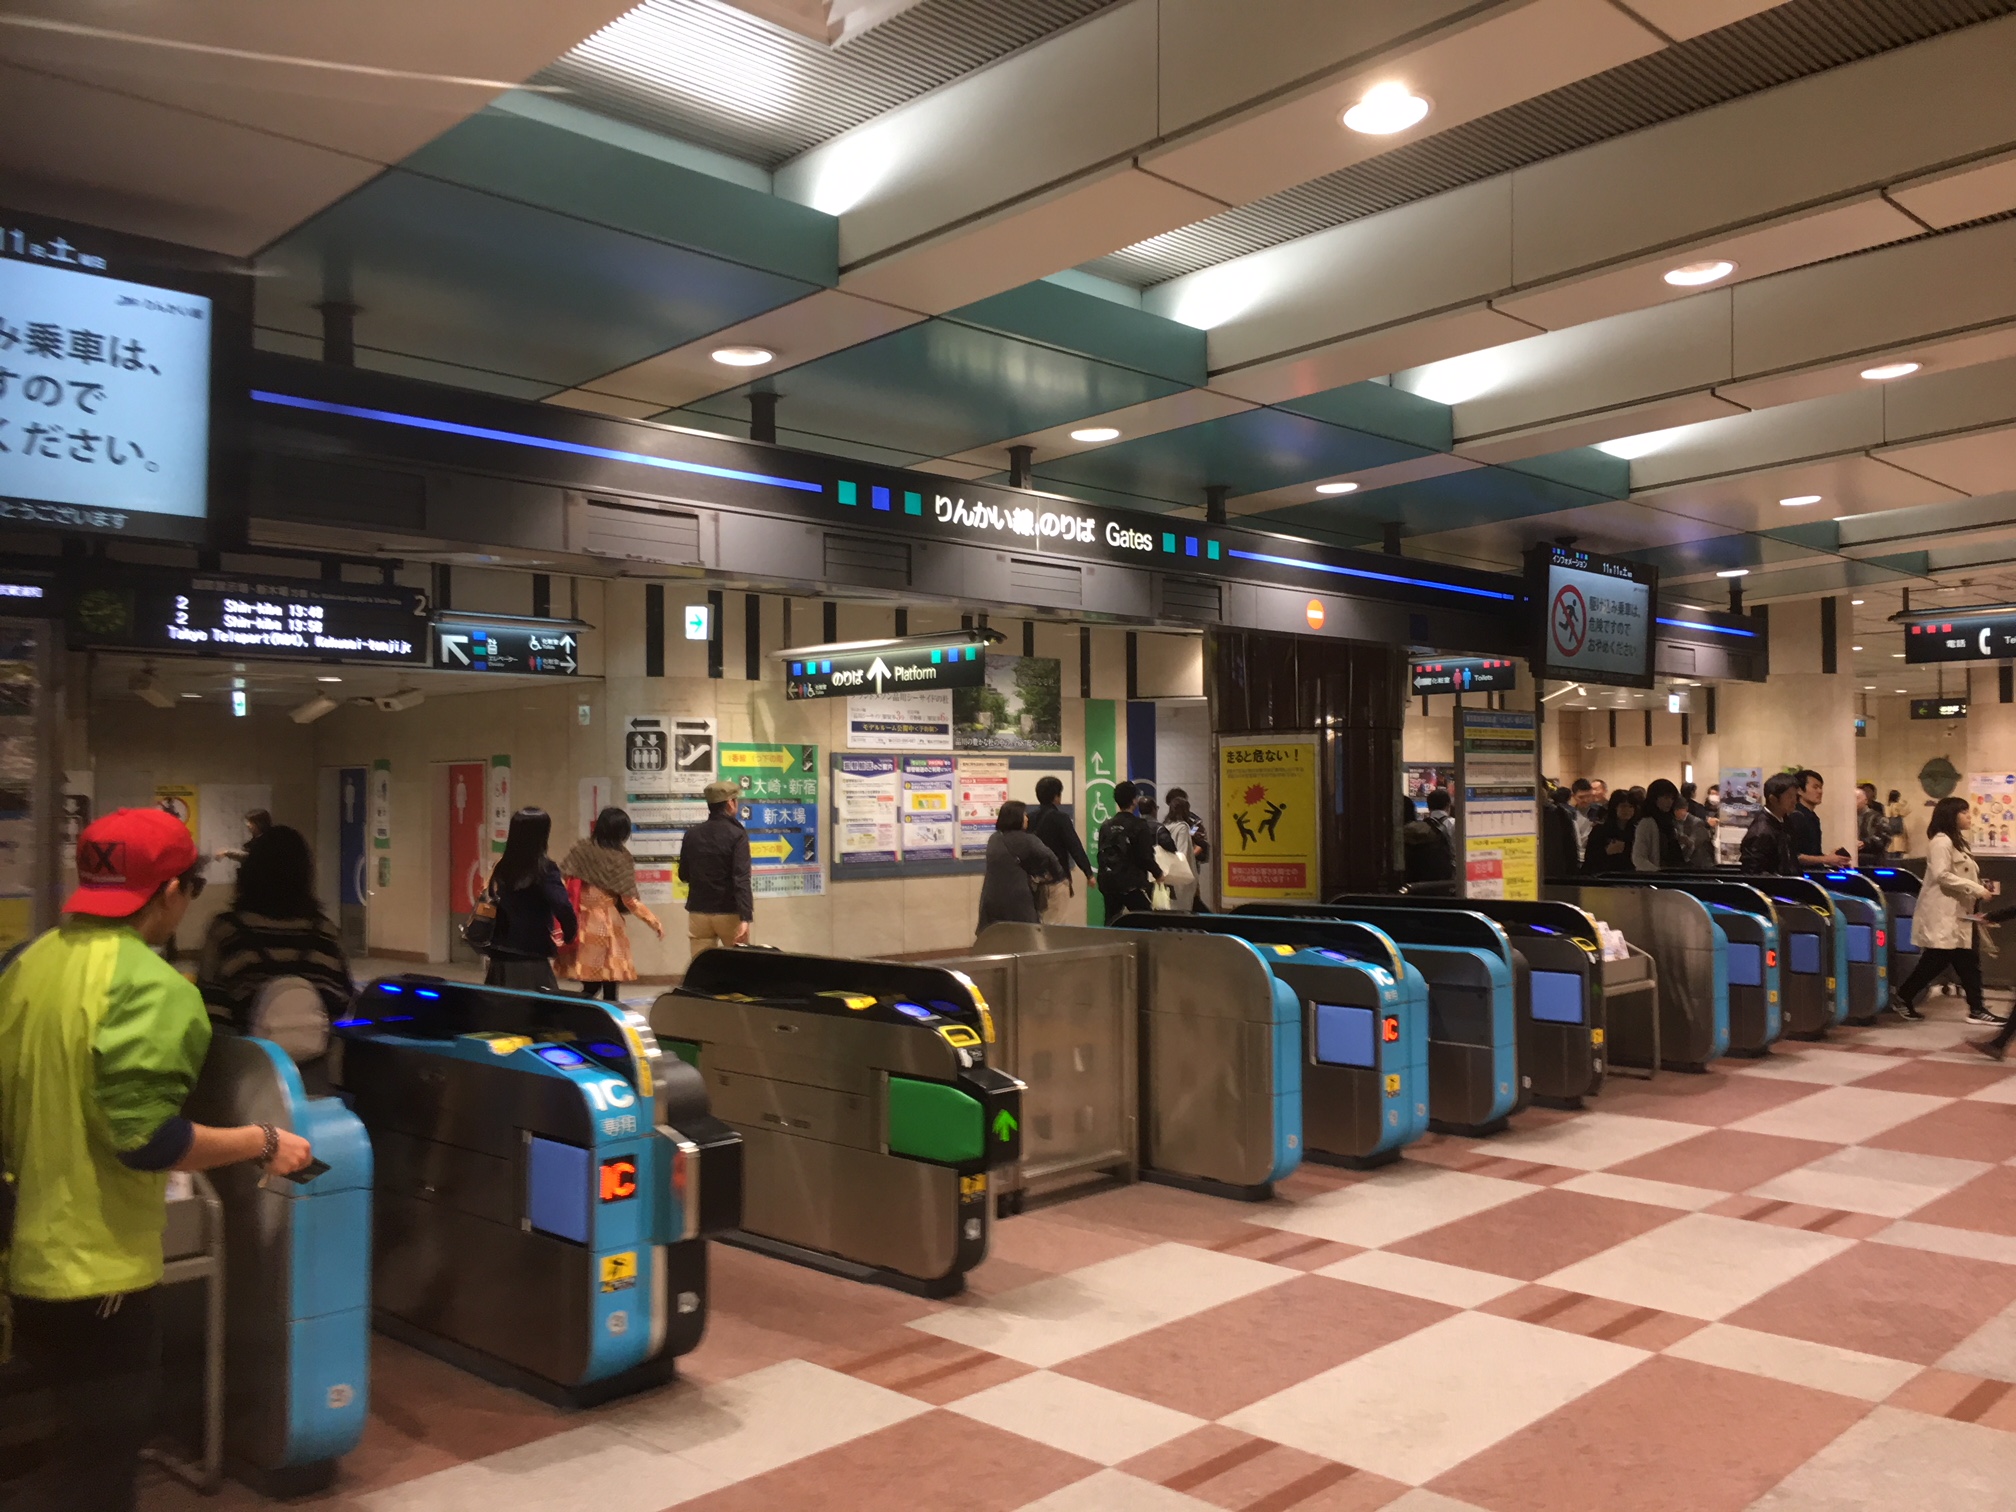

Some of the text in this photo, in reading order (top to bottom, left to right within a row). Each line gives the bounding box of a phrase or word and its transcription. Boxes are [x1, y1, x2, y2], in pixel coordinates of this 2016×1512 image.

[934, 493, 1153, 552] りんかい線のりば Gates
[175, 594, 190, 611] 2
[414, 595, 427, 617] 2
[174, 610, 189, 626] 2
[831, 664, 937, 687] のりば Platform
[1474, 674, 1494, 682] Toilets
[1227, 748, 1299, 764] 走ると危ない！
[753, 778, 817, 797] 大崎・新宿
[764, 806, 807, 825] 新木場
[1367, 967, 1395, 987] IC
[584, 1079, 635, 1110] IC
[600, 1162, 636, 1200] IC
